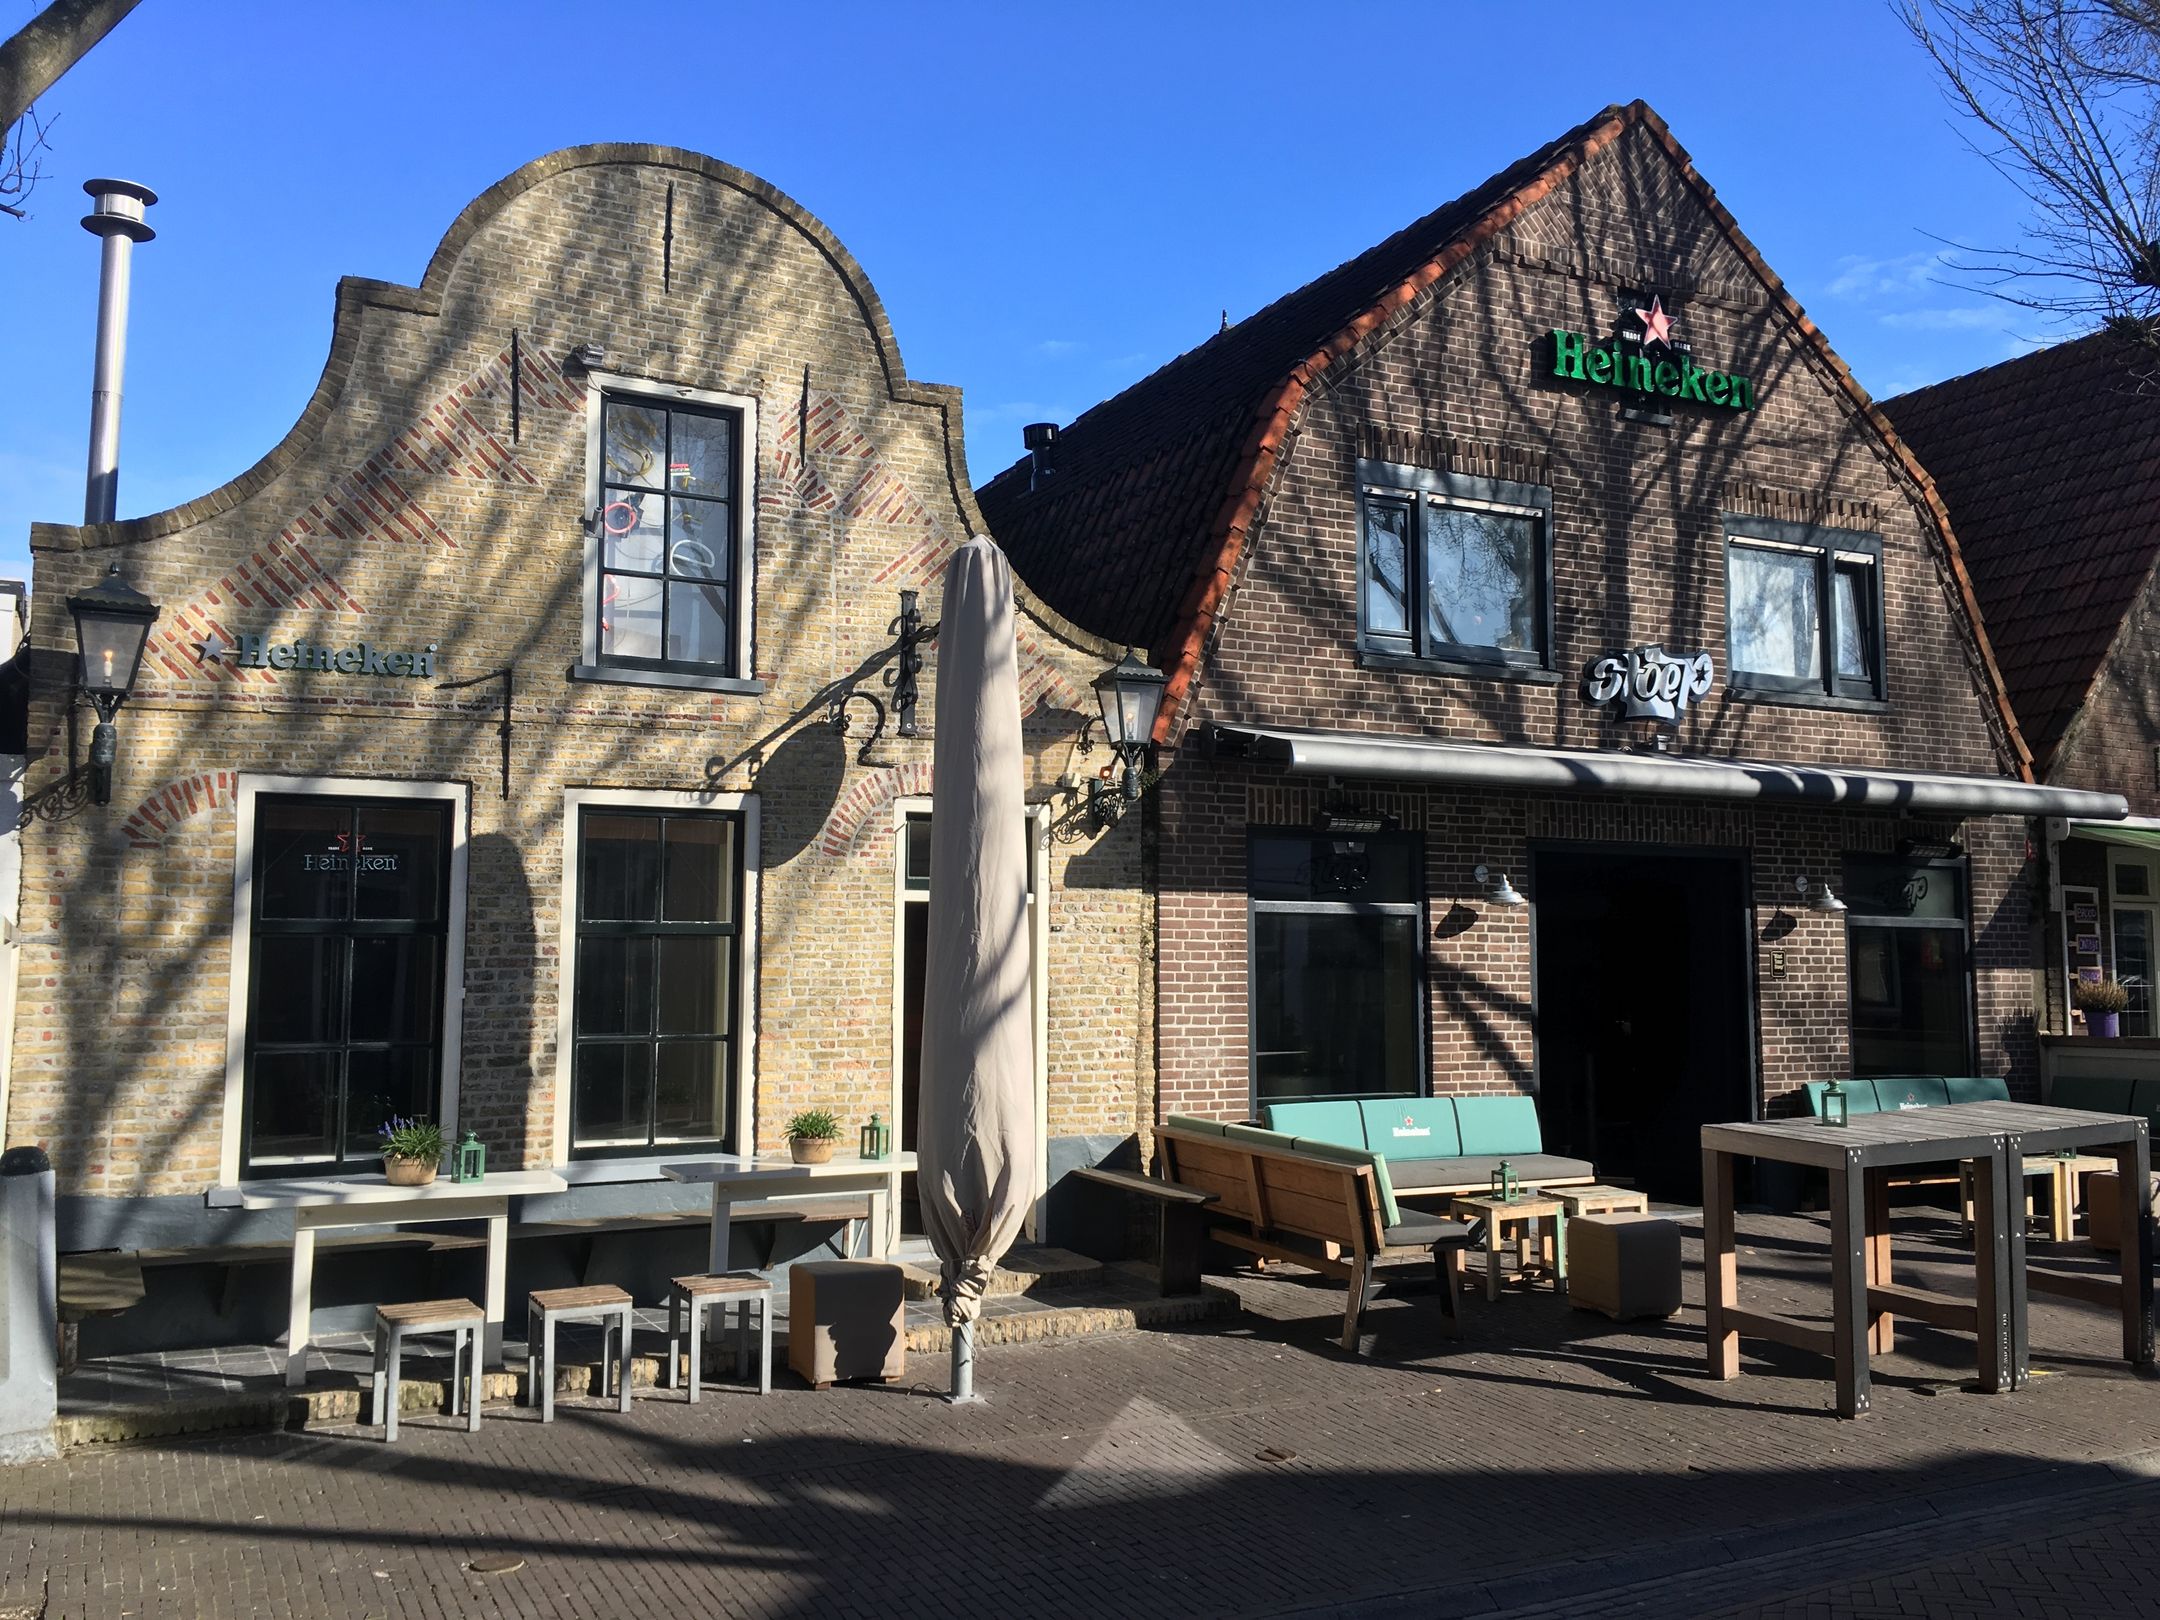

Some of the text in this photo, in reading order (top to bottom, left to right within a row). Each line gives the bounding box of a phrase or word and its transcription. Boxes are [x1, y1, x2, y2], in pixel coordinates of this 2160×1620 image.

[1622, 331, 1641, 341] TRADE
[1553, 328, 1756, 411] Heineken
[236, 632, 435, 677] Heineken
